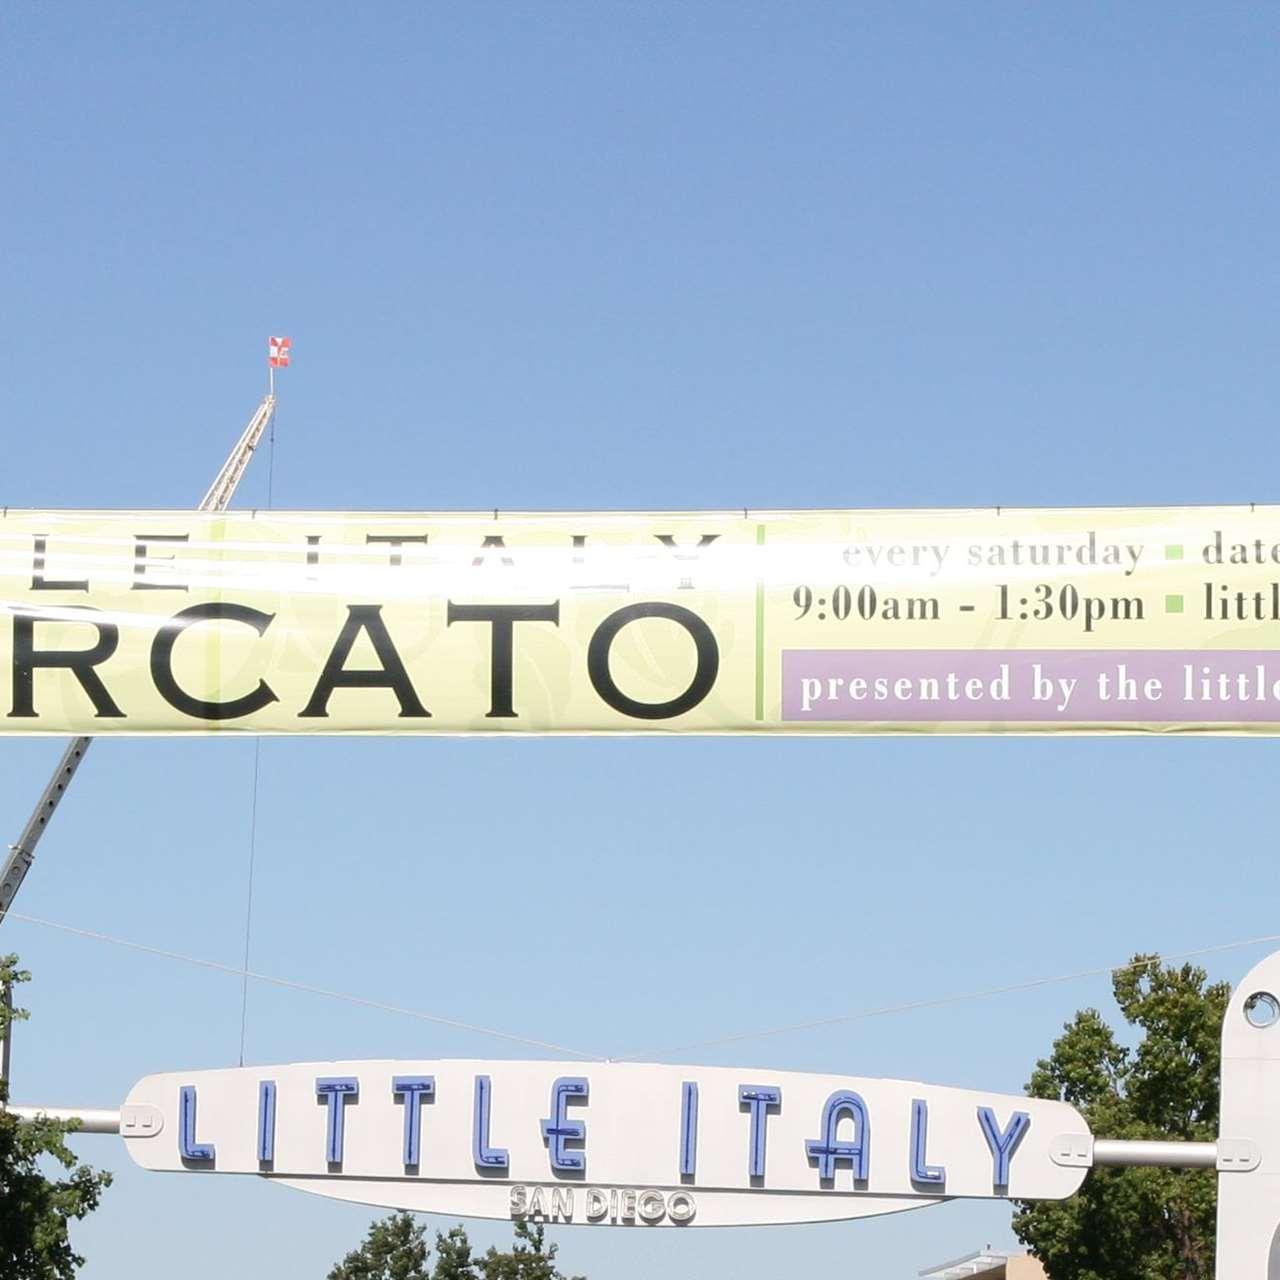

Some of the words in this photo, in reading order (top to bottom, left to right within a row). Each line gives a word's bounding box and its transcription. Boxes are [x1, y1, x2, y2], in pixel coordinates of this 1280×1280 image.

[305, 533, 722, 593] ITALY
[842, 542, 951, 577] every
[967, 531, 1145, 576] saturday
[793, 584, 941, 621] 9:00am
[994, 583, 1145, 632] 1:30pm
[801, 664, 1011, 711] presented
[1032, 664, 1077, 711] by
[1097, 664, 1163, 701] the
[178, 1075, 589, 1172] LITTLE
[681, 1081, 1030, 1186] ITALY
[510, 1185, 575, 1221] SAN
[586, 1188, 697, 1225] DIEGO
